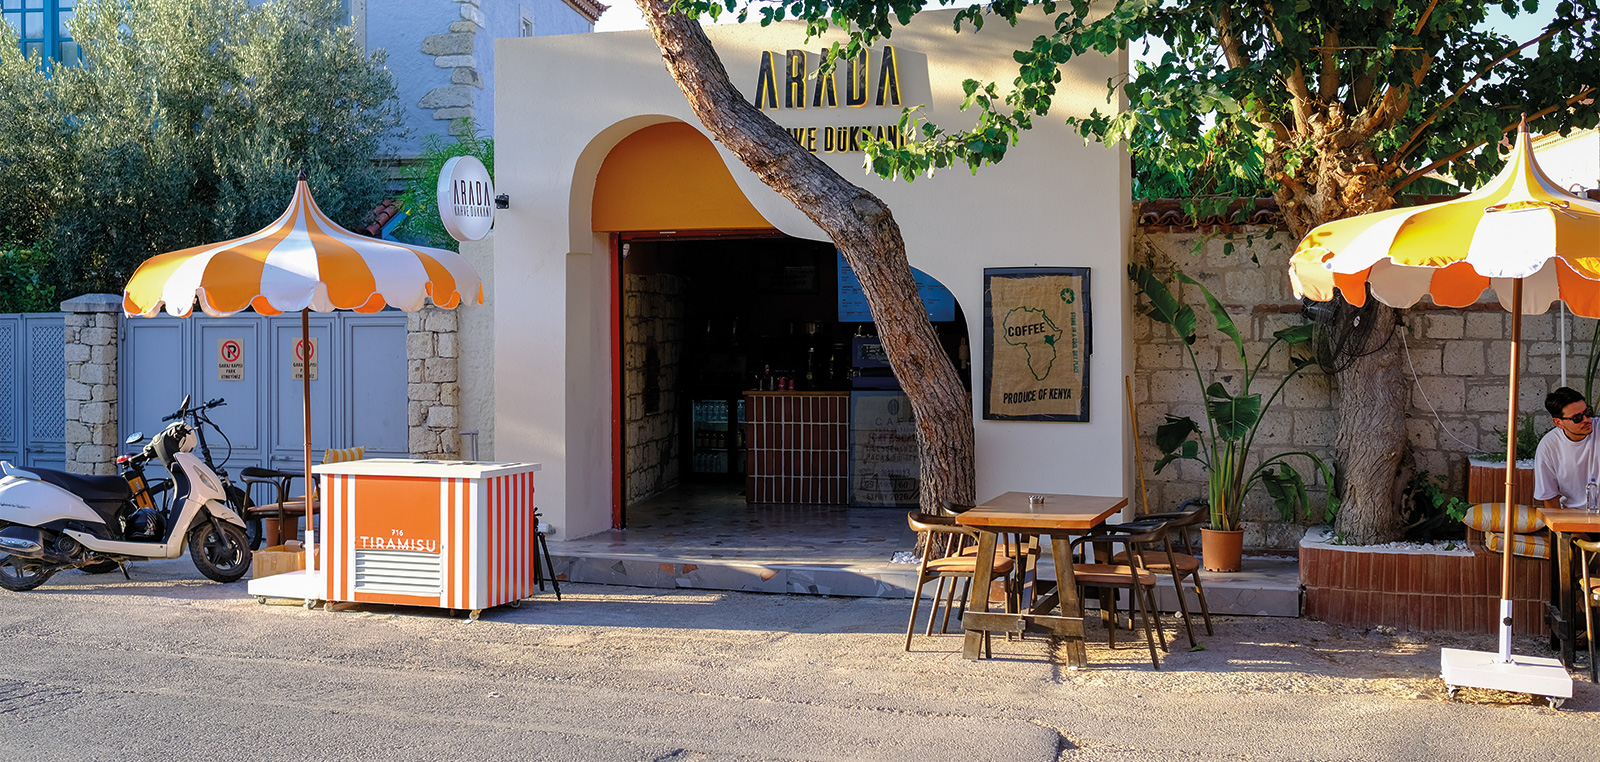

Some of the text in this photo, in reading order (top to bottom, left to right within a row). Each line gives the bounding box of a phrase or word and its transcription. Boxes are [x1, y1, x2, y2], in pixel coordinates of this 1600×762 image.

[755, 45, 901, 110] ARADA
[453, 179, 491, 207] ARADA
[1008, 322, 1046, 337] COFFEE
[1003, 388, 1072, 404] PRODUCE OF KENYA
[360, 536, 436, 552] TIRAMISU
